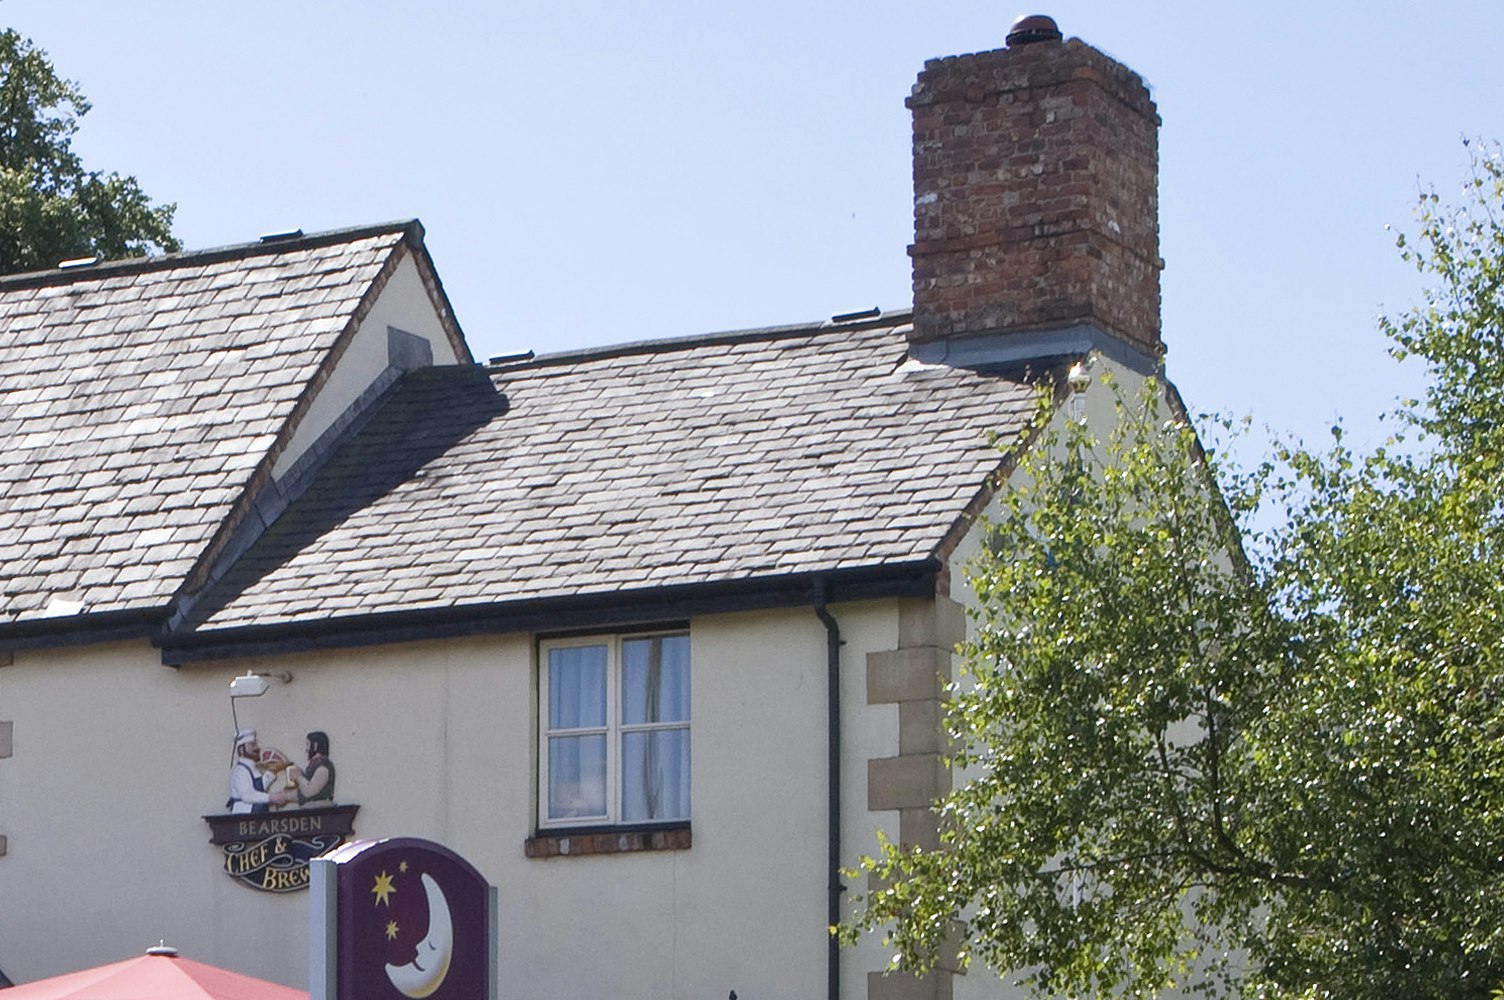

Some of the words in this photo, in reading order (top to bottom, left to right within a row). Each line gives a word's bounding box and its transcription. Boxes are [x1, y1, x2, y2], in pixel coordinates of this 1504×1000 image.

[239, 816, 321, 836] BEARSDEN
[226, 843, 268, 875] CHEF
[274, 837, 287, 854] &
[263, 867, 311, 890] BREW
